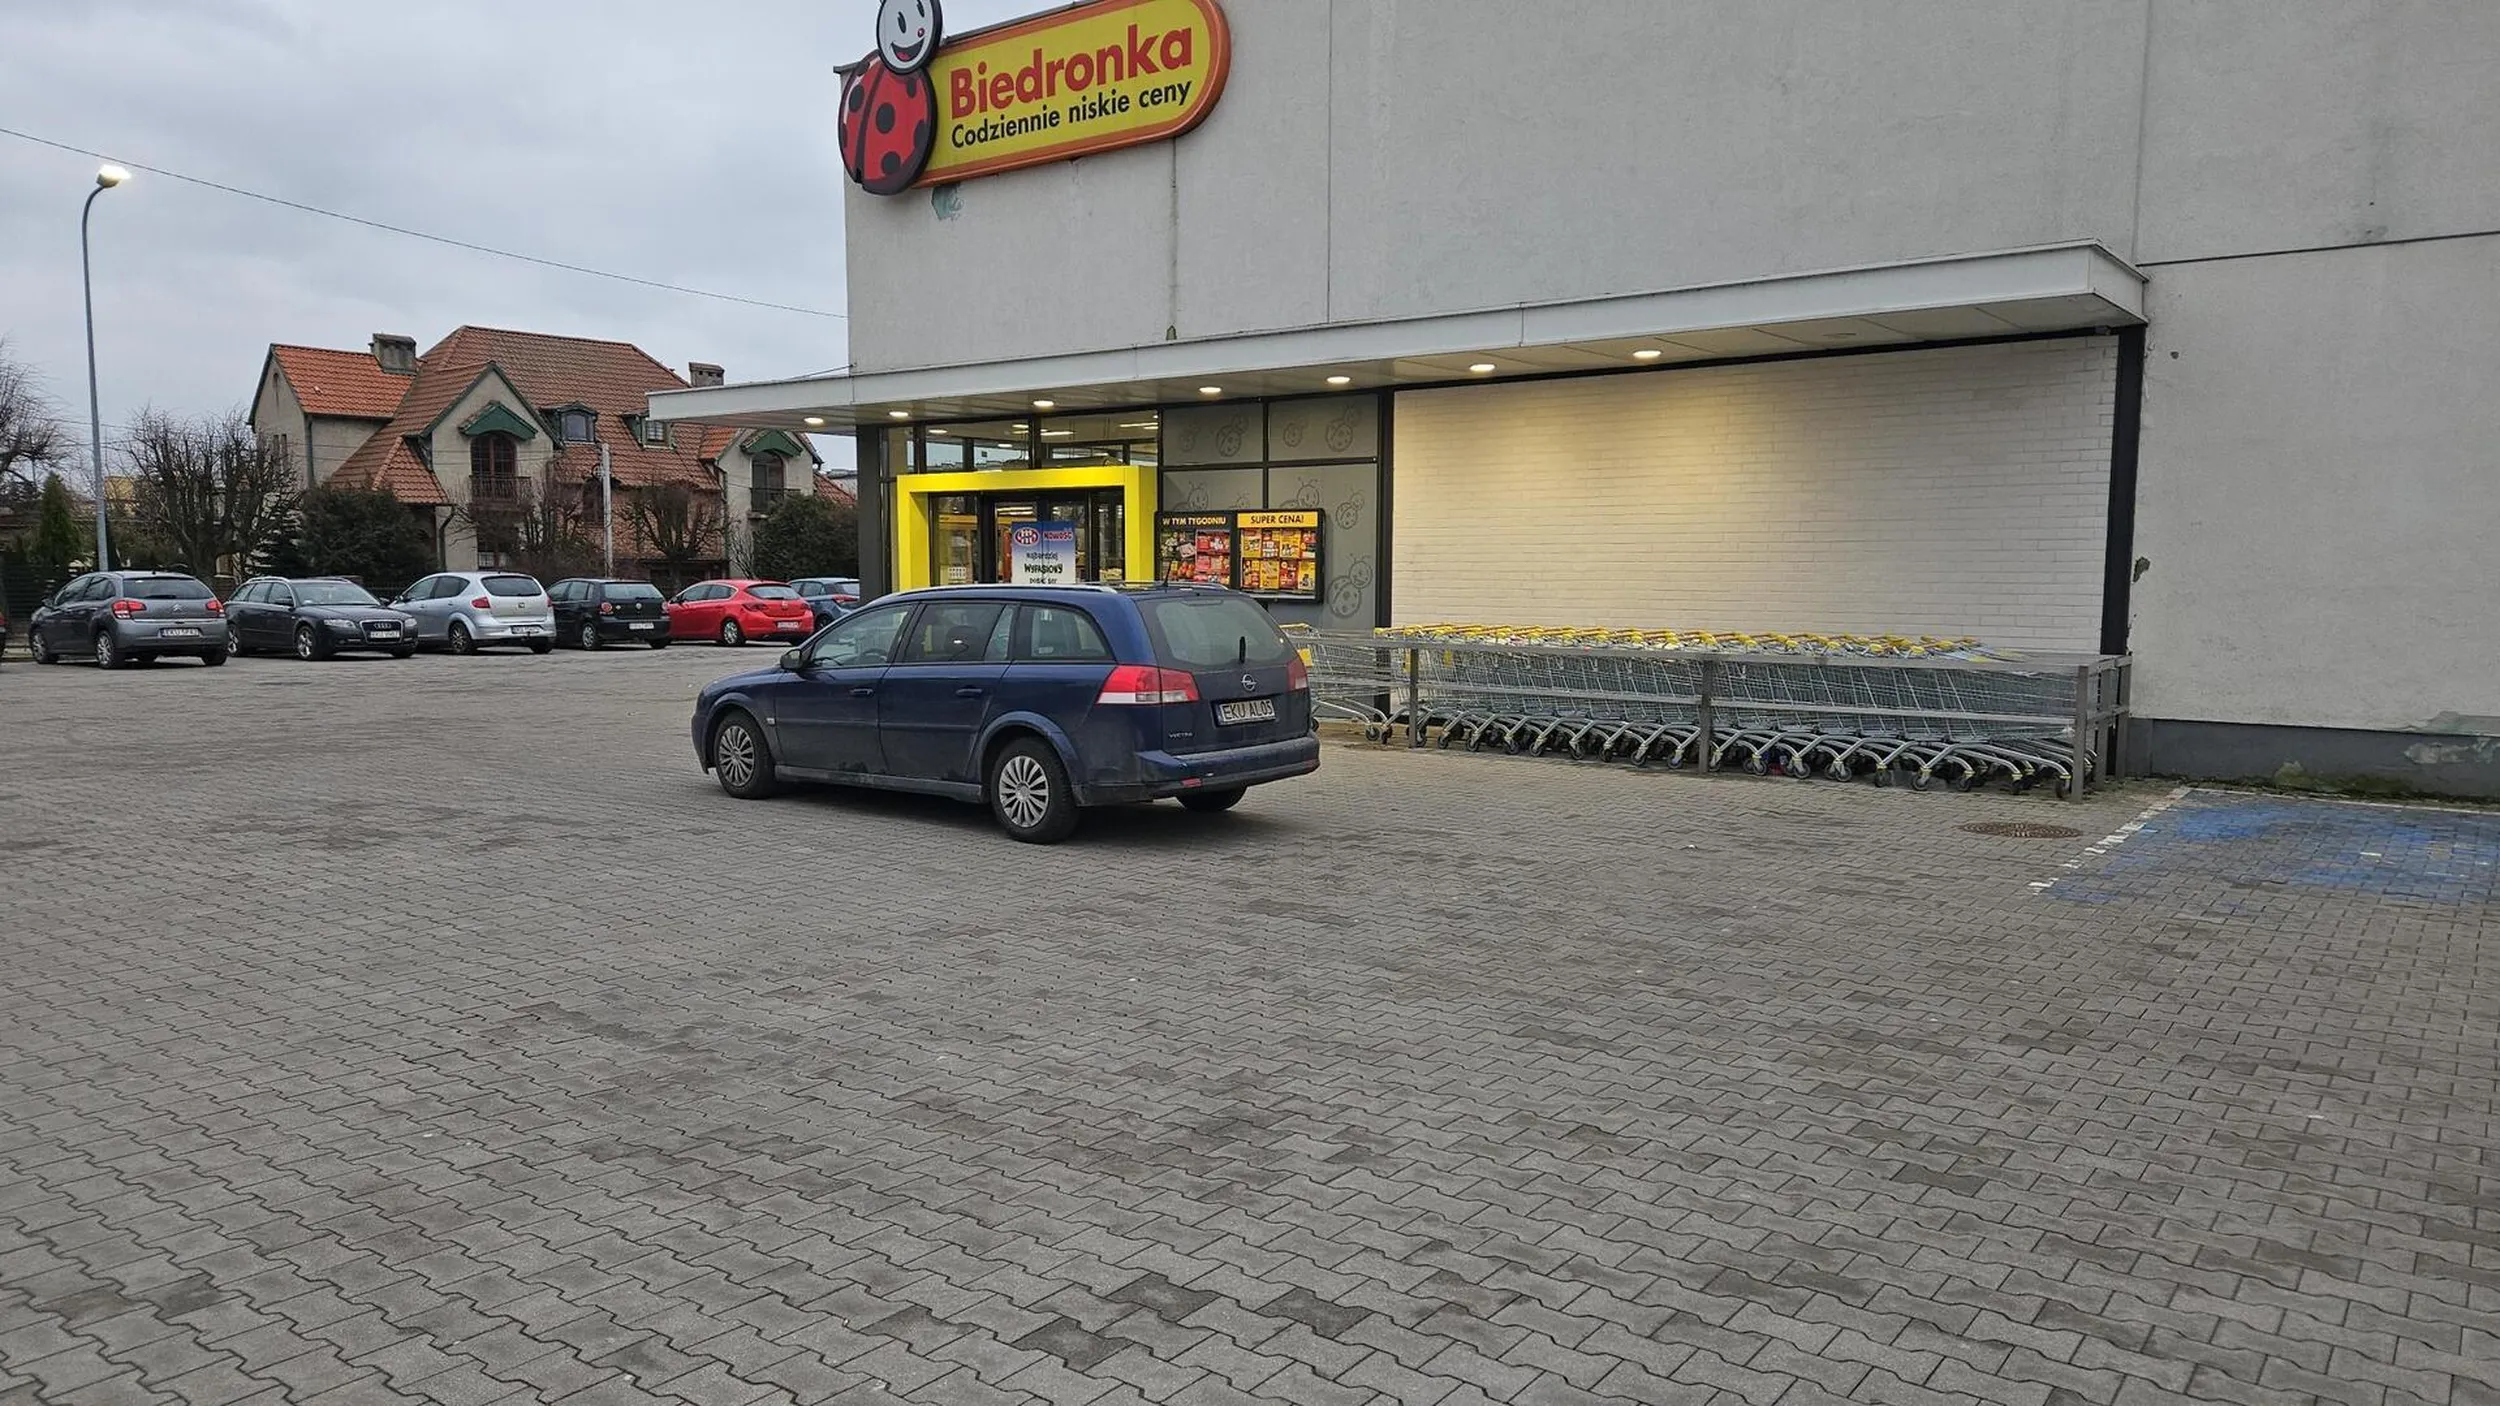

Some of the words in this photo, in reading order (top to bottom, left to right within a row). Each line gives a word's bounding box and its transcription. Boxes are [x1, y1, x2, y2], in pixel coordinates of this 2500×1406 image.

[950, 23, 1193, 120] Biedronka
[951, 105, 1060, 149] Codziennie
[1068, 88, 1131, 125] niskie
[1138, 80, 1192, 108] ceny
[1162, 517, 1171, 526] W
[1171, 516, 1187, 525] TYM
[1188, 515, 1227, 525] TYGODNIU
[1250, 514, 1277, 525] SUPER
[1278, 514, 1305, 524] CENA!
[1221, 703, 1246, 720] EKU
